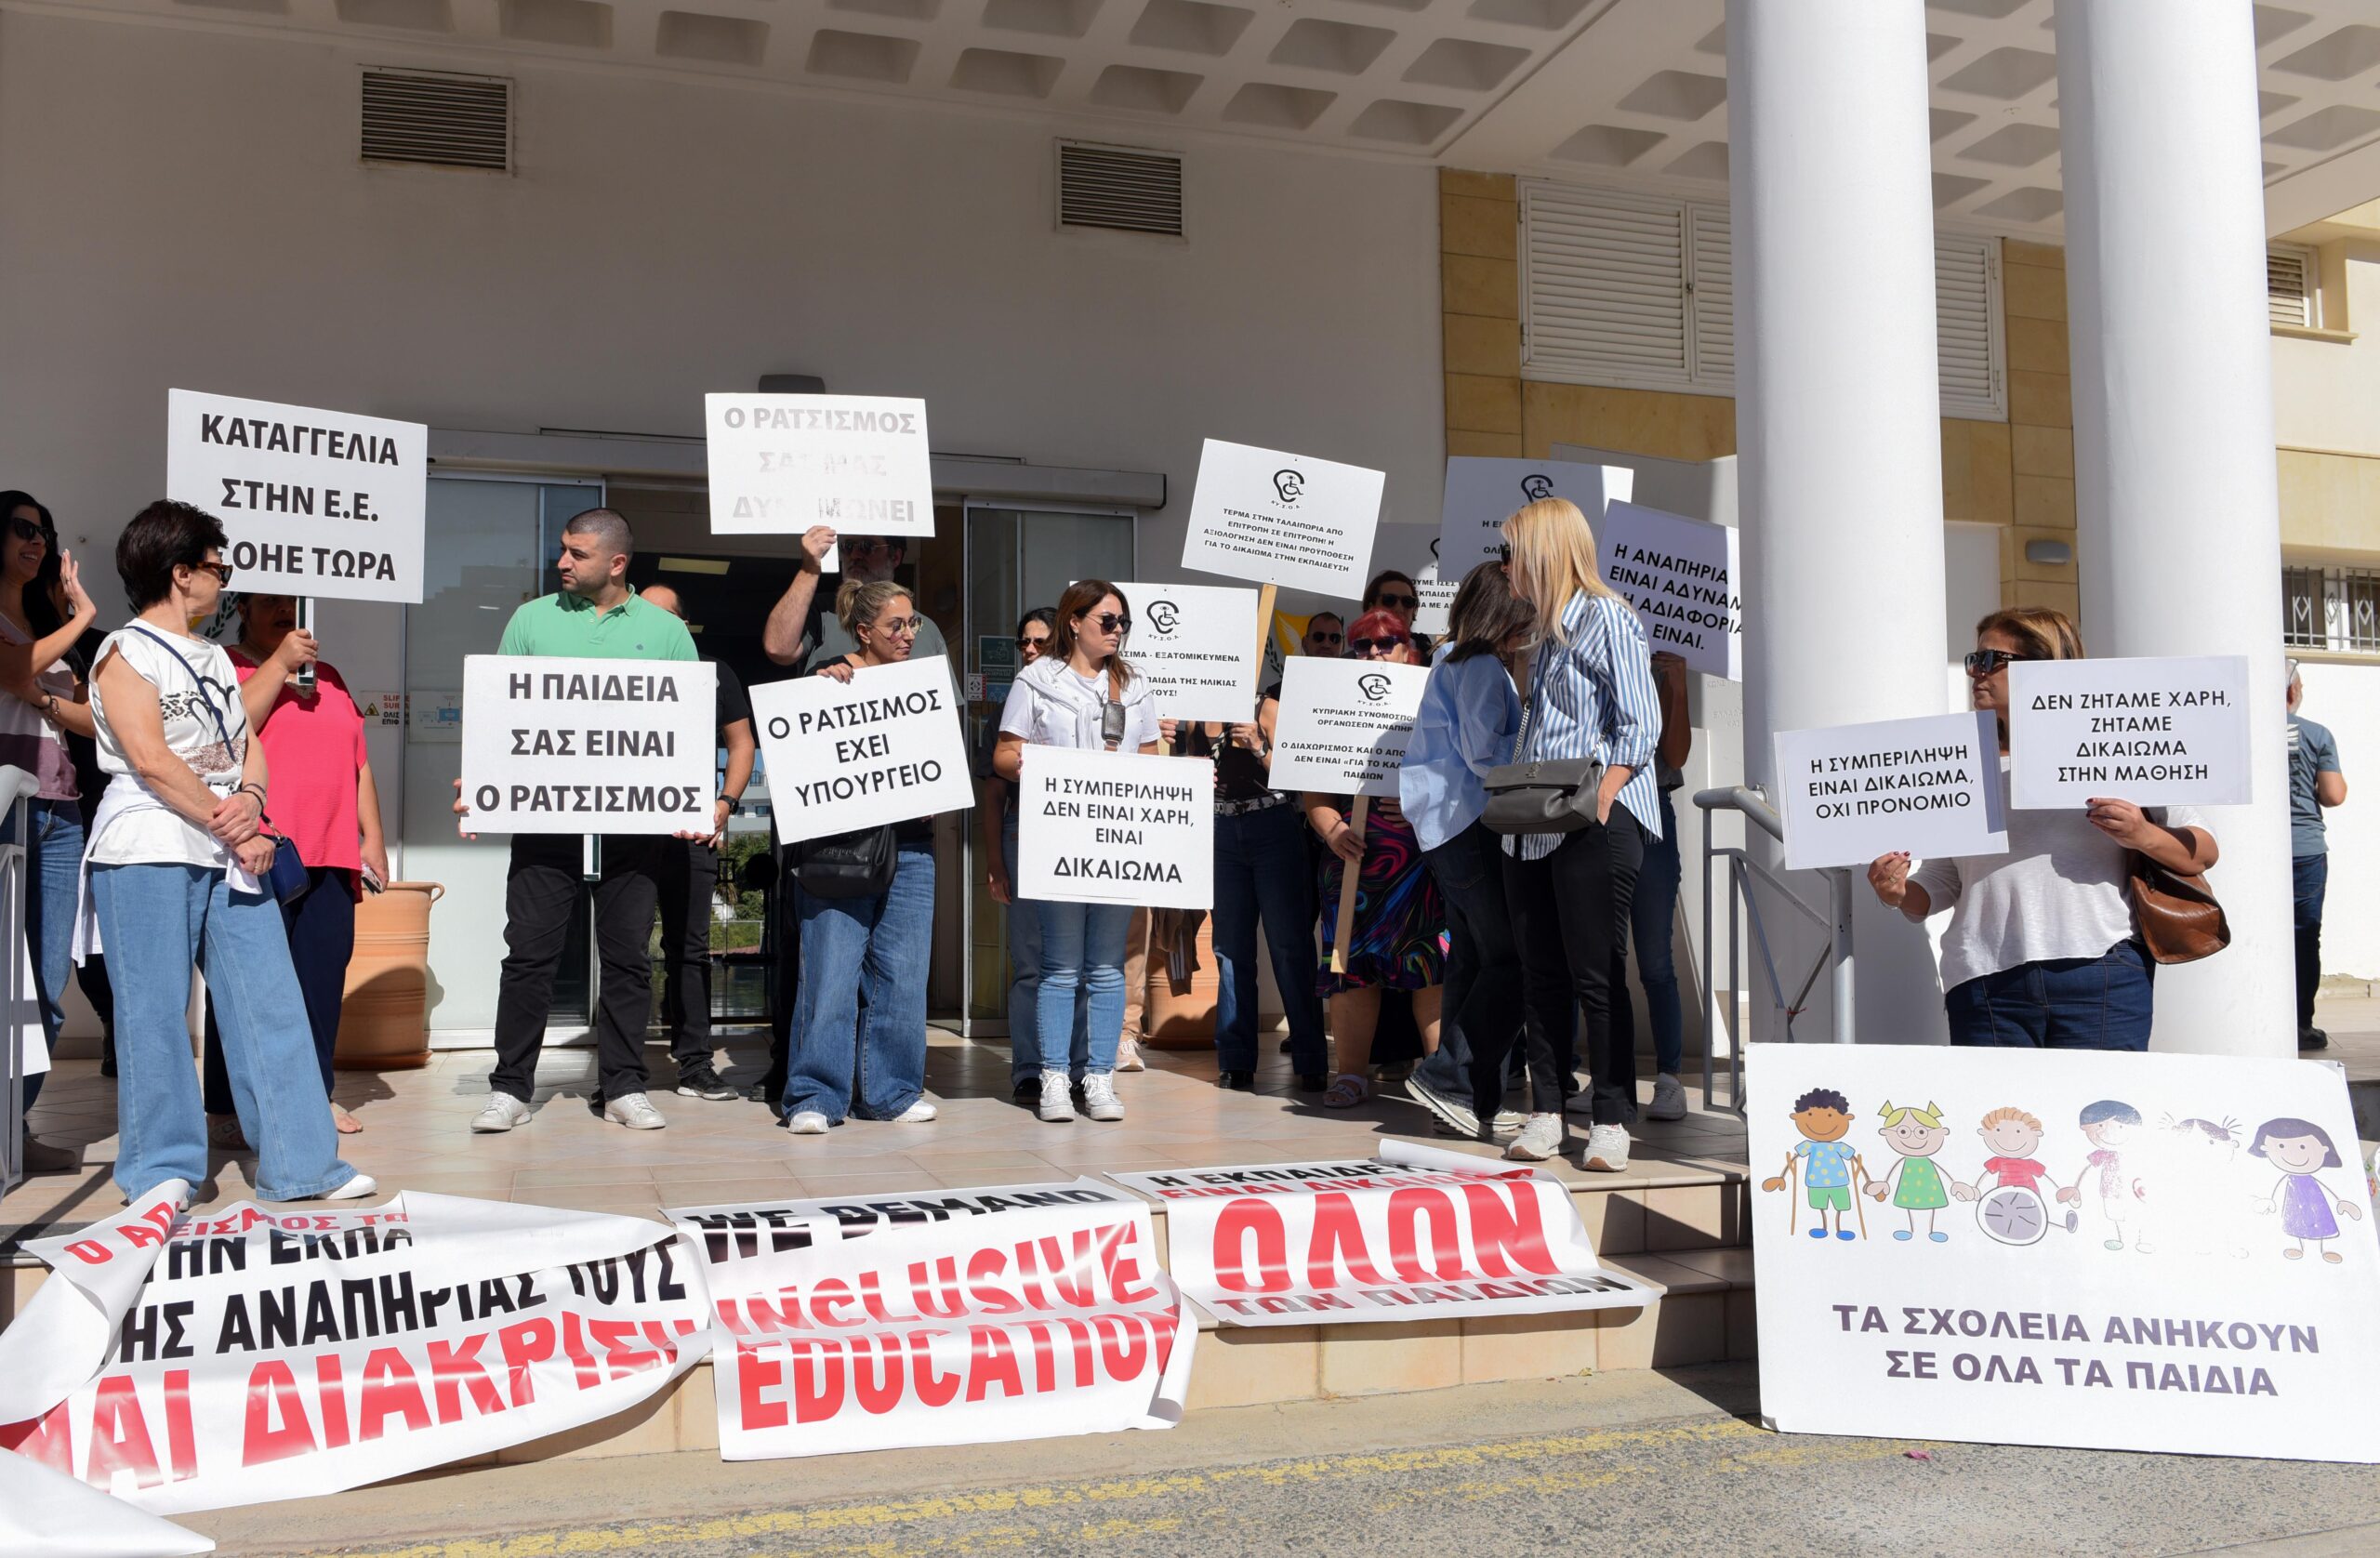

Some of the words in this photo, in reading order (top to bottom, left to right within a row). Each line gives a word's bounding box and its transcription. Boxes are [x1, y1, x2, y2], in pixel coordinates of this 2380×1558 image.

[724, 407, 746, 429] Ο
[754, 408, 916, 434] ΡΑΤΣΙΣΜΟΣ
[201, 413, 399, 466] ΚΑΤΑΓΓΕΛΙΑ
[220, 478, 314, 515] ΣΤΗΝ
[324, 489, 378, 522] Ε.Ε.
[1223, 508, 1250, 519] ΤΕΡΜΑ
[1252, 513, 1274, 522] ΣΤΗΝ
[1276, 518, 1324, 533] ΤΑΛΑΙΠΩΡΙΑ
[1326, 527, 1343, 536] ΑΠΟ
[1228, 521, 1269, 535] ΕΠΙΤΡΟΠΗ
[1283, 531, 1326, 545] ΕΠΙΤΡΟΠΗ!
[1203, 528, 1255, 543] ΑΞΙΟΛΟΓΗΣΗ
[1276, 541, 1297, 550] ΕΙΝΑΙ
[311, 547, 396, 581] ΤΩΡΑ
[1233, 545, 1272, 558] ΔΙΚΑΙΩΜΑ
[1275, 553, 1296, 562] ΣΤΗΝ
[1298, 557, 1349, 572] ΕΚΠΑΙΔΕΥΣΗ
[1615, 543, 1627, 559] Η
[1632, 548, 1728, 584] ΑΝΑΠΗΡΙΑ
[1609, 565, 1658, 590] ΕΙΝΑΙ
[1652, 624, 1704, 650] ΕΙΝΑΙ.
[1155, 652, 1240, 662] ΕΞΑΤΟΜΙΚΕΥΜΕΝΑ
[509, 673, 532, 699] Η
[543, 673, 679, 702] ΠΑΙΔΕΙΑ
[1200, 679, 1236, 687] ΗΛΙΚΙΑΣ
[1312, 707, 1355, 716] ΚΥΠΡΙΑΚΗ
[2031, 694, 2072, 710] ΔΕΝ
[2080, 692, 2161, 709] ΖΗΤΑΜΕ
[2168, 690, 2231, 707] ΧΑΡΗ,
[768, 717, 790, 739] Ο
[799, 689, 942, 734] ΡΑΤΣΙΣΜΟΣ
[1317, 719, 1374, 729] ΟΡΓΑΝΩΣΕΩΝ
[1377, 723, 1413, 733] ΑΝΑΠΗΡ
[2091, 716, 2172, 733] ΖΗΤΑΜΕ
[511, 729, 576, 756] ΣΑΣ
[587, 730, 674, 757] ΕΙΝΑΙ
[836, 733, 890, 763] ΕΧΕΙ
[1290, 743, 1354, 753] ΔΙΑΧΩΡΙΣΜΟΣ
[1356, 746, 1373, 755] ΚΑΙ
[1385, 748, 1406, 758] ΑΠΟ
[2076, 740, 2187, 758] ΔΙΚΑΙΩΜΑ
[1367, 759, 1380, 768] ΤΟ
[1811, 759, 1822, 773] Η
[1829, 745, 1967, 772] ΣΥΜΠΕΡΙΛΗΨΗ
[795, 759, 942, 807] ΥΠΟΥΡΓΕΙΟ
[1343, 771, 1383, 781] ΠΑΙΔΙΩΝ
[1808, 778, 1858, 797] ΕΙΝΑΙ
[1864, 769, 1974, 791] ΔΙΚΑΙΩΜΑ,
[2057, 766, 2107, 782] ΣΤΗΝ
[2114, 764, 2208, 781] ΜΑΘΗΣΗ
[475, 785, 500, 812] Ο
[510, 786, 701, 812] ΡΑΤΣΙΣΜΟΣ
[1045, 777, 1057, 792] Η
[1064, 778, 1193, 801] ΣΥΜΠΕΡΙΛΗΨΗ
[1043, 800, 1080, 817] ΔΕΝ
[1087, 803, 1133, 821] ΕΙΝΑΙ
[1141, 807, 1194, 827] ΧΑΡΗ,
[1816, 802, 1850, 818] ΟΧΙ
[1857, 791, 1971, 815] ΠΡΟΝΟΜΙΟ
[1095, 827, 1143, 845] ΕΙΝΑΙ
[1054, 856, 1183, 883] ΔΙΚΑΙΩΜΑ
[1148, 1175, 1190, 1187] Η
[1190, 1163, 1435, 1184] ΕΚΠΑΙΔΕΥ
[1153, 1183, 1295, 1199] ΕΙΝΑΙ
[1302, 1169, 1508, 1192] ΔΙΚΑΙΩ
[684, 1208, 813, 1264] WE
[818, 1189, 1118, 1240] DEMAND
[1213, 1181, 1564, 1293] ΟΛΩΝ
[270, 1226, 413, 1265] ΕΚΠΑ
[716, 1220, 1158, 1337] INCLUSIVE
[1211, 1293, 1355, 1316] ΤΩΝ
[1357, 1275, 1634, 1307] ΠΑΙΔΙΩΝ
[104, 1301, 194, 1365] ΗΣ
[1832, 1304, 1889, 1333] ΤΑ
[1902, 1306, 2090, 1342] ΣΧΟΛΕΙΑ
[2103, 1316, 2319, 1353] ΑΝΗΚΟΥΝ
[1885, 1350, 1938, 1380] ΣΕ
[1952, 1353, 2043, 1384] ΟΛΑ
[2054, 1357, 2113, 1388] ΤΑ
[2125, 1361, 2279, 1396] ΠΑΙΔΙΑ
